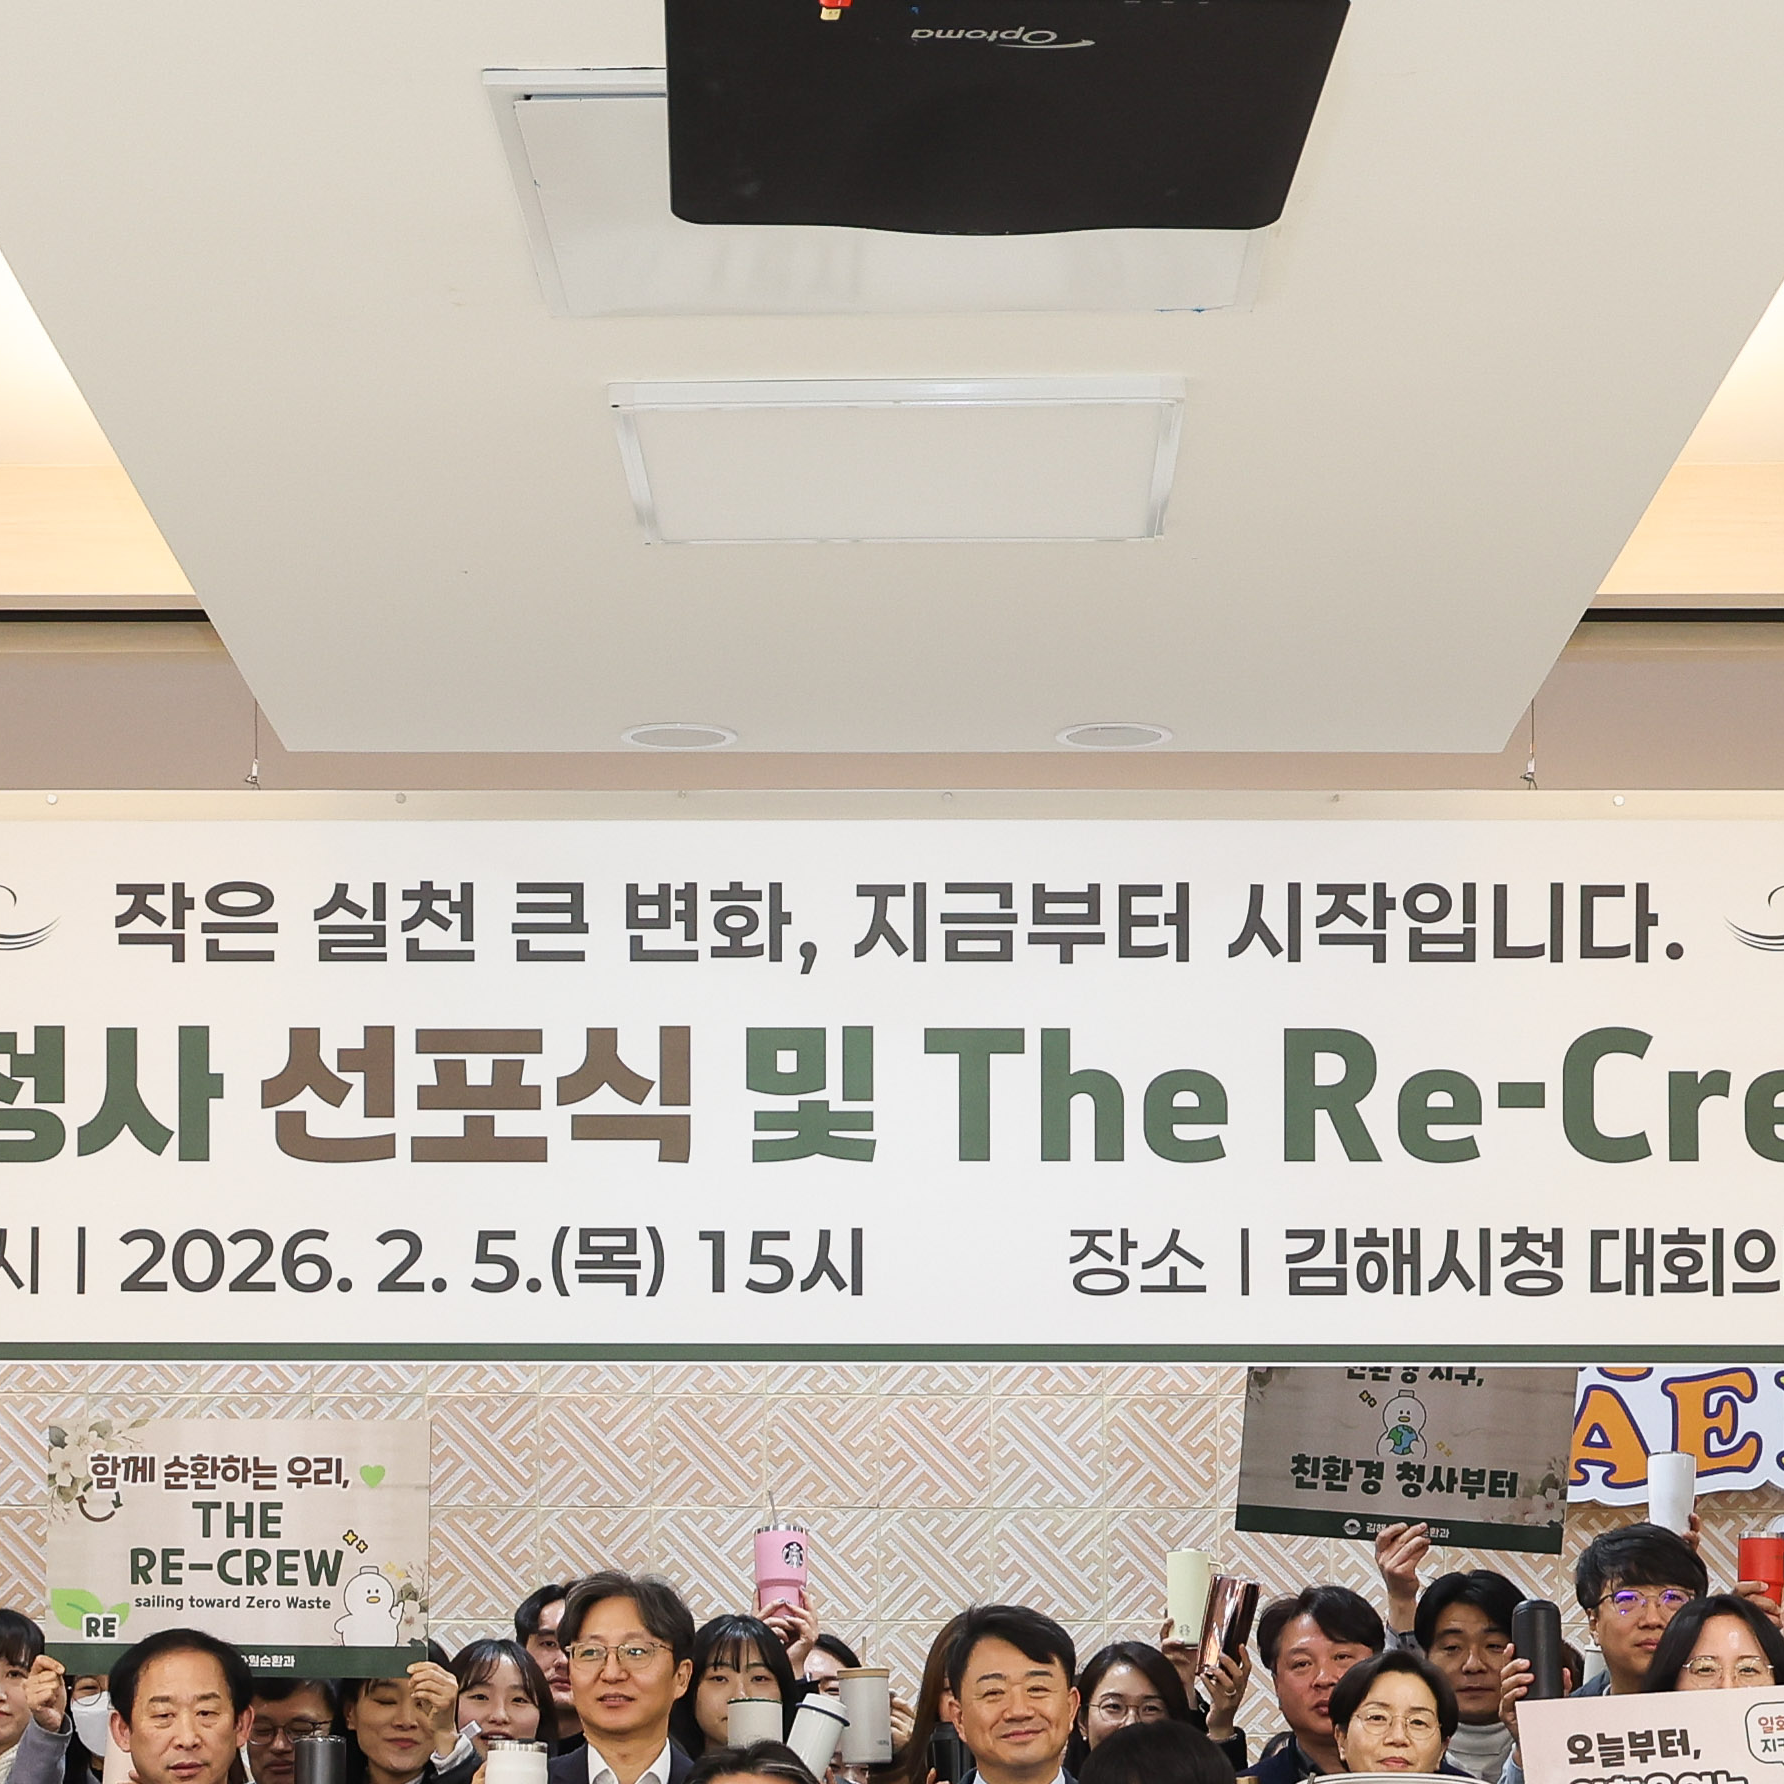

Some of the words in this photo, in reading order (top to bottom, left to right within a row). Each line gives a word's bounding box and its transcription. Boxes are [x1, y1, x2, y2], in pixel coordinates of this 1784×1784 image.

[910, 26, 1058, 45] Optoma
[112, 880, 281, 964] 작은
[312, 880, 479, 963] 실천
[508, 881, 591, 962] 큰
[623, 880, 819, 976] 변화,
[852, 880, 1193, 964] 지금부터
[1227, 880, 1685, 964] 시작입니다.
[259, 1023, 694, 1165] 선포식
[744, 1023, 878, 1165] 및
[923, 1025, 1229, 1165] The
[119, 1227, 355, 1295] 2026.
[377, 1227, 450, 1295] 2.
[471, 1224, 666, 1299] 5.(목)
[701, 1226, 865, 1296] 15시
[1068, 1226, 1208, 1298] 장소
[1284, 1226, 1567, 1298] 김해시청
[90, 1454, 155, 1489] 함께
[163, 1454, 277, 1490] 순환하는
[287, 1456, 350, 1489] 우리,
[1290, 1453, 1385, 1495] 친환경
[1395, 1460, 1519, 1500] 청사부터
[192, 1501, 283, 1538] THE
[129, 1548, 344, 1586] RE-CREW
[134, 1595, 184, 1611] sailing
[189, 1595, 240, 1609] toward
[246, 1596, 281, 1609] Zero
[286, 1596, 331, 1610] Waste
[85, 1616, 117, 1638] RE
[1565, 1727, 1703, 1768] 오늘부터,
